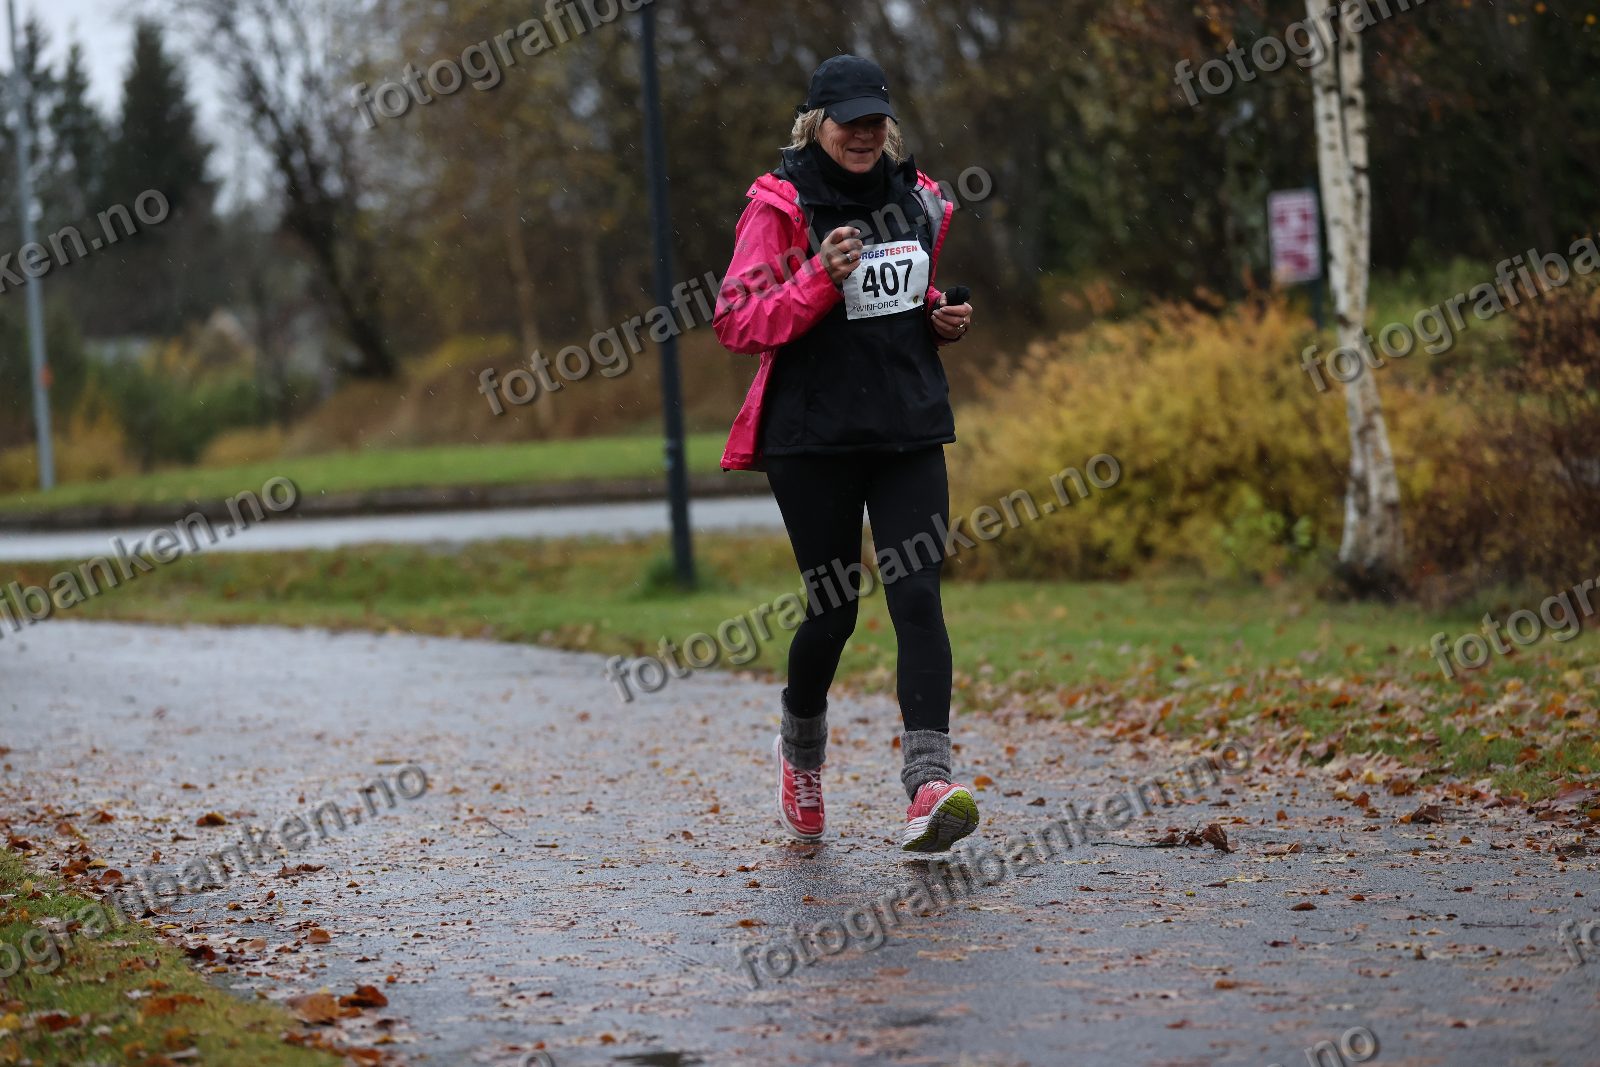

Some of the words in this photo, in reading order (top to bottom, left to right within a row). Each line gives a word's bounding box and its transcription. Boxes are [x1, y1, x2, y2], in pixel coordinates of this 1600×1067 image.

[860, 245, 917, 260] RGESTESTEN
[862, 258, 913, 298] 407
[856, 299, 899, 313] WINFORCE
